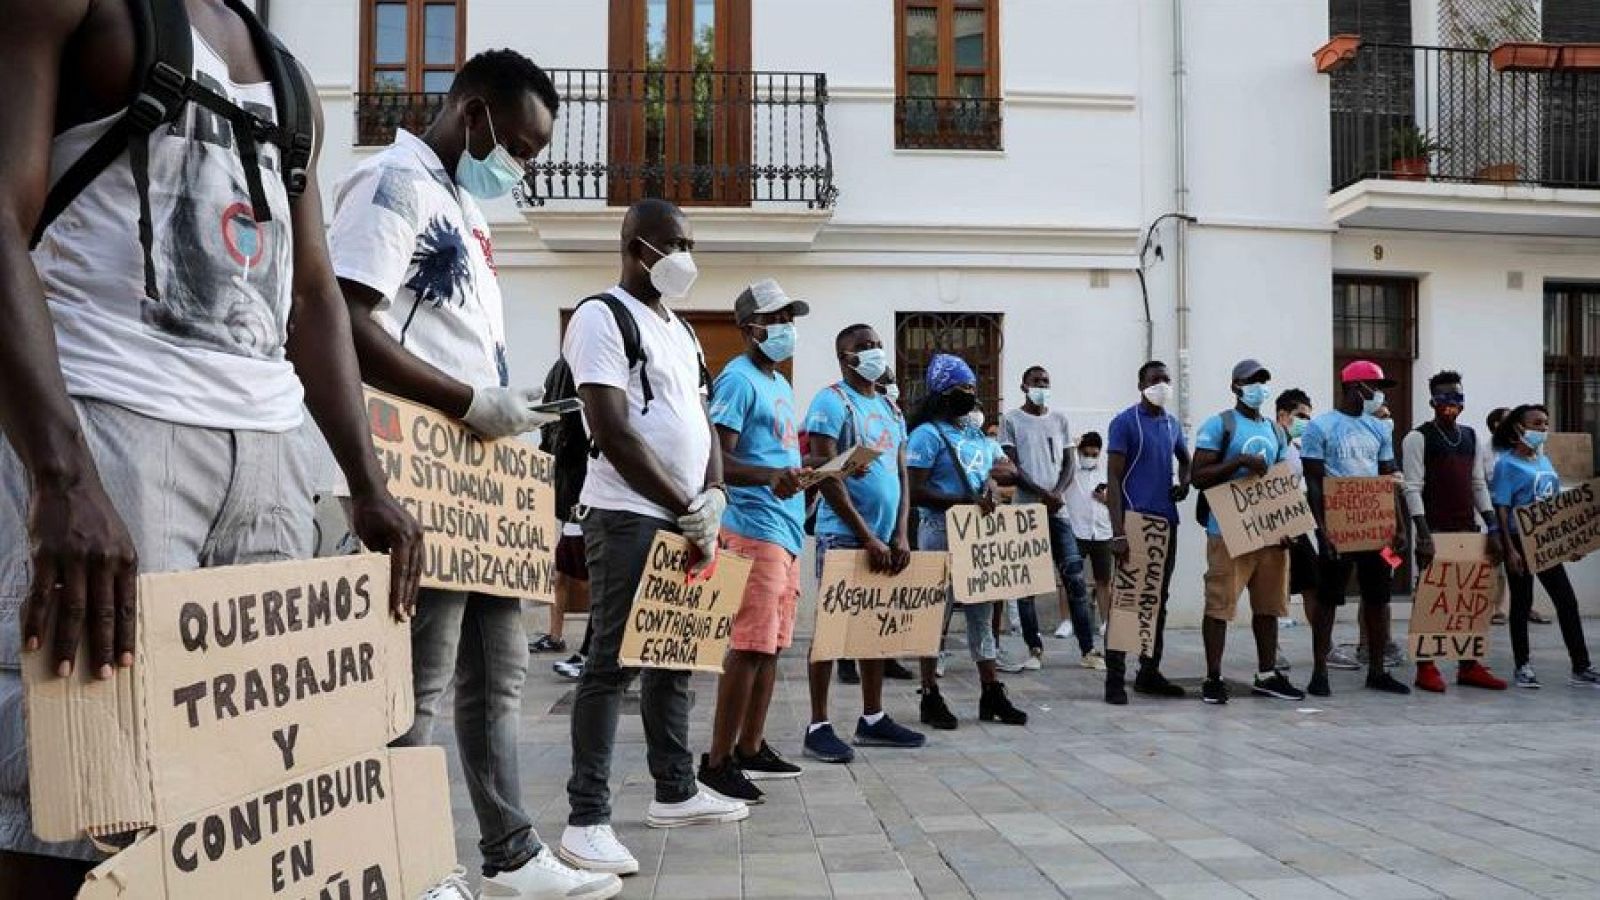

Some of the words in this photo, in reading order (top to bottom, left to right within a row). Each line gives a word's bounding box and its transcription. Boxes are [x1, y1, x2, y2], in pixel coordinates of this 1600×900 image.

[1373, 244, 1384, 261] 9
[412, 415, 486, 467] COVID
[494, 444, 527, 481] NOS
[516, 486, 536, 512] DE
[1516, 483, 1594, 537] DERECHOS
[952, 510, 1007, 541] VIDA
[1015, 508, 1038, 535] DE
[423, 544, 541, 595] ULARIZACIÓN
[971, 538, 1050, 569] REFUGIADO
[966, 563, 1032, 596] IMPORTA
[1423, 560, 1492, 590] LIVE
[644, 573, 703, 609] TRABAJAR
[708, 589, 720, 611] Y
[1429, 591, 1489, 617] AND
[178, 573, 371, 654] QUEREMOS
[635, 607, 712, 641] CONTRIBUIR
[714, 616, 732, 640] EN
[877, 611, 913, 637] YA!!!
[1445, 614, 1476, 631] LET
[640, 632, 698, 665] ESPAÑA
[1415, 634, 1485, 658] LIVE
[172, 641, 375, 728] TRABAJAR
[271, 723, 300, 771] Y
[171, 758, 386, 873] CONTRIBUIR
[270, 839, 315, 893] EN
